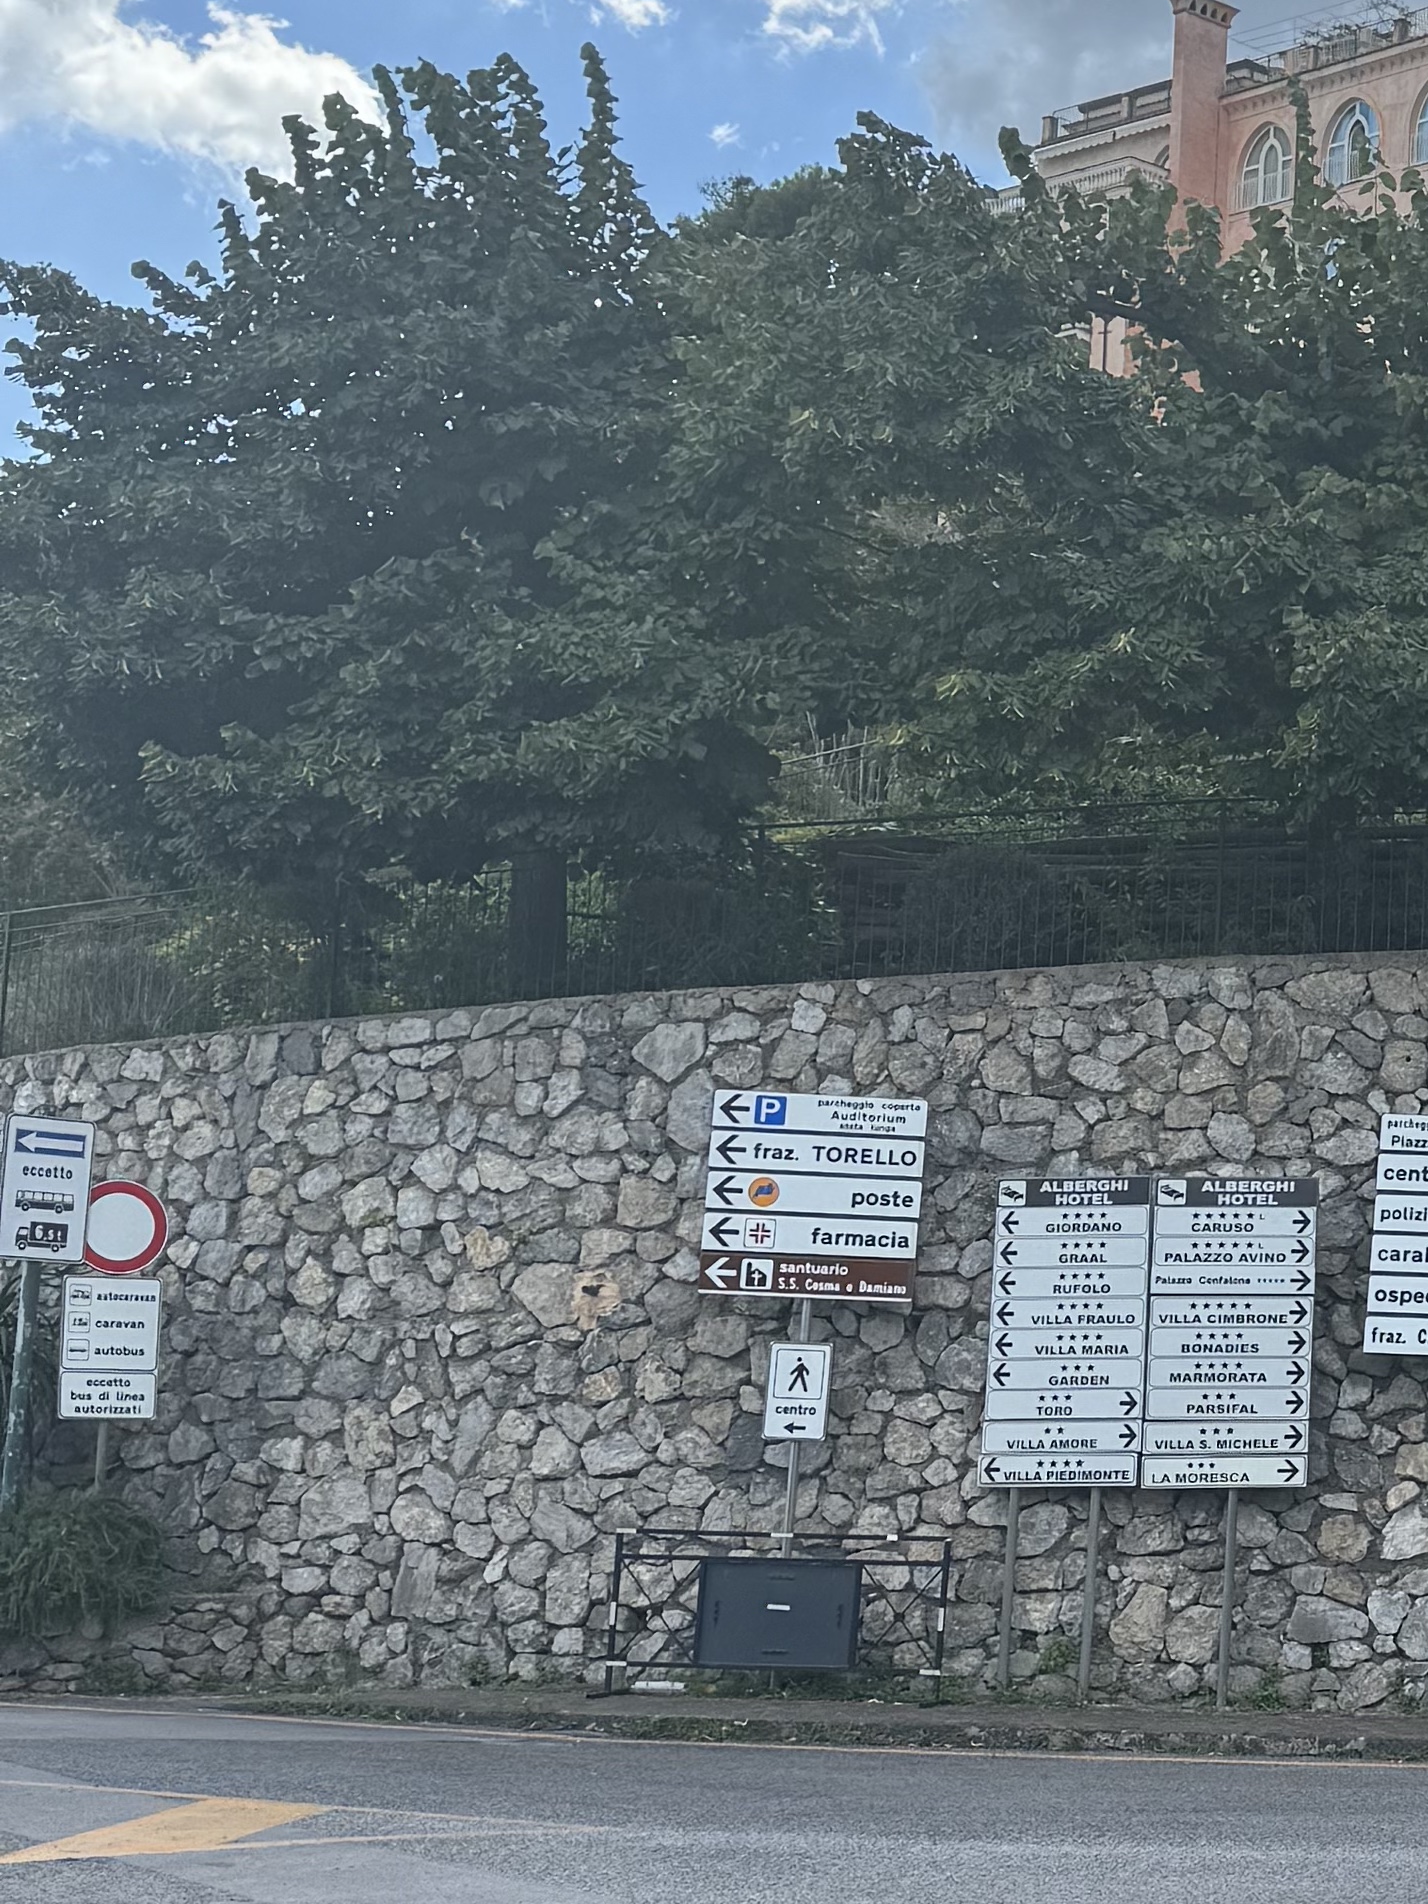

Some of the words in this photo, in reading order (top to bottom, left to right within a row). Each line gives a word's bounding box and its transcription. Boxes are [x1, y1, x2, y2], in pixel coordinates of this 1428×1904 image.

[818, 1099, 874, 1110] parcheggio
[759, 1099, 781, 1123] P
[830, 1110, 906, 1124] Auditorium
[753, 1142, 799, 1161] fraz.
[812, 1145, 917, 1166] TORELLO
[22, 1165, 73, 1180] eccetto
[1039, 1179, 1129, 1192] ALBERGHI
[1201, 1180, 1296, 1192] ALBERGHI
[851, 1190, 914, 1208] poste
[1055, 1193, 1113, 1205] HOTEL
[1217, 1193, 1278, 1206] HOTEL
[1045, 1222, 1122, 1233] GIORDANO
[1191, 1222, 1254, 1233] CARUSO
[811, 1227, 910, 1249] farmacia
[1058, 1253, 1107, 1263] GRAAL
[1164, 1252, 1233, 1263] PALAZZO
[1238, 1253, 1286, 1263] AVINO
[779, 1262, 848, 1276] santuario
[778, 1277, 800, 1290] S.S.
[804, 1278, 840, 1292] Cosma
[859, 1281, 907, 1295] Damiano
[1155, 1276, 1192, 1285] Palazzo
[1199, 1276, 1251, 1285] Confalone
[1053, 1283, 1111, 1294] RUFOLO
[96, 1292, 156, 1302] autocaravan
[95, 1319, 145, 1329] caravan
[1031, 1315, 1072, 1325] VILLA
[1077, 1314, 1135, 1324] FRAULO
[1159, 1314, 1202, 1324] VILLA
[1207, 1314, 1288, 1324] CIMBRONE
[1371, 1327, 1406, 1344] fraz.
[94, 1346, 145, 1356] autobus
[1035, 1345, 1077, 1355] VILLA
[1081, 1344, 1129, 1355] MARIA
[1181, 1344, 1259, 1353] BONADIES
[86, 1378, 131, 1387] eccetto
[1048, 1375, 1110, 1386] GARDEN
[1169, 1372, 1267, 1383] MARMORATA
[70, 1390, 92, 1400] bus
[98, 1391, 109, 1401] di
[116, 1392, 145, 1401] linea
[74, 1405, 141, 1414] autorizzati
[775, 1404, 816, 1415] centro
[1035, 1406, 1073, 1416] TORO
[1186, 1404, 1258, 1414] PARSIFAL
[1006, 1439, 1045, 1449] VILLA
[1049, 1438, 1098, 1449] AMORE
[1154, 1440, 1194, 1450] VILLA
[1199, 1439, 1211, 1449] S.
[1216, 1439, 1279, 1449] MICHELE
[1003, 1471, 1042, 1481] VILLA
[1046, 1470, 1130, 1481] PIEDIMONTE
[1152, 1473, 1170, 1484] LA
[1175, 1472, 1250, 1483] MORESCA
